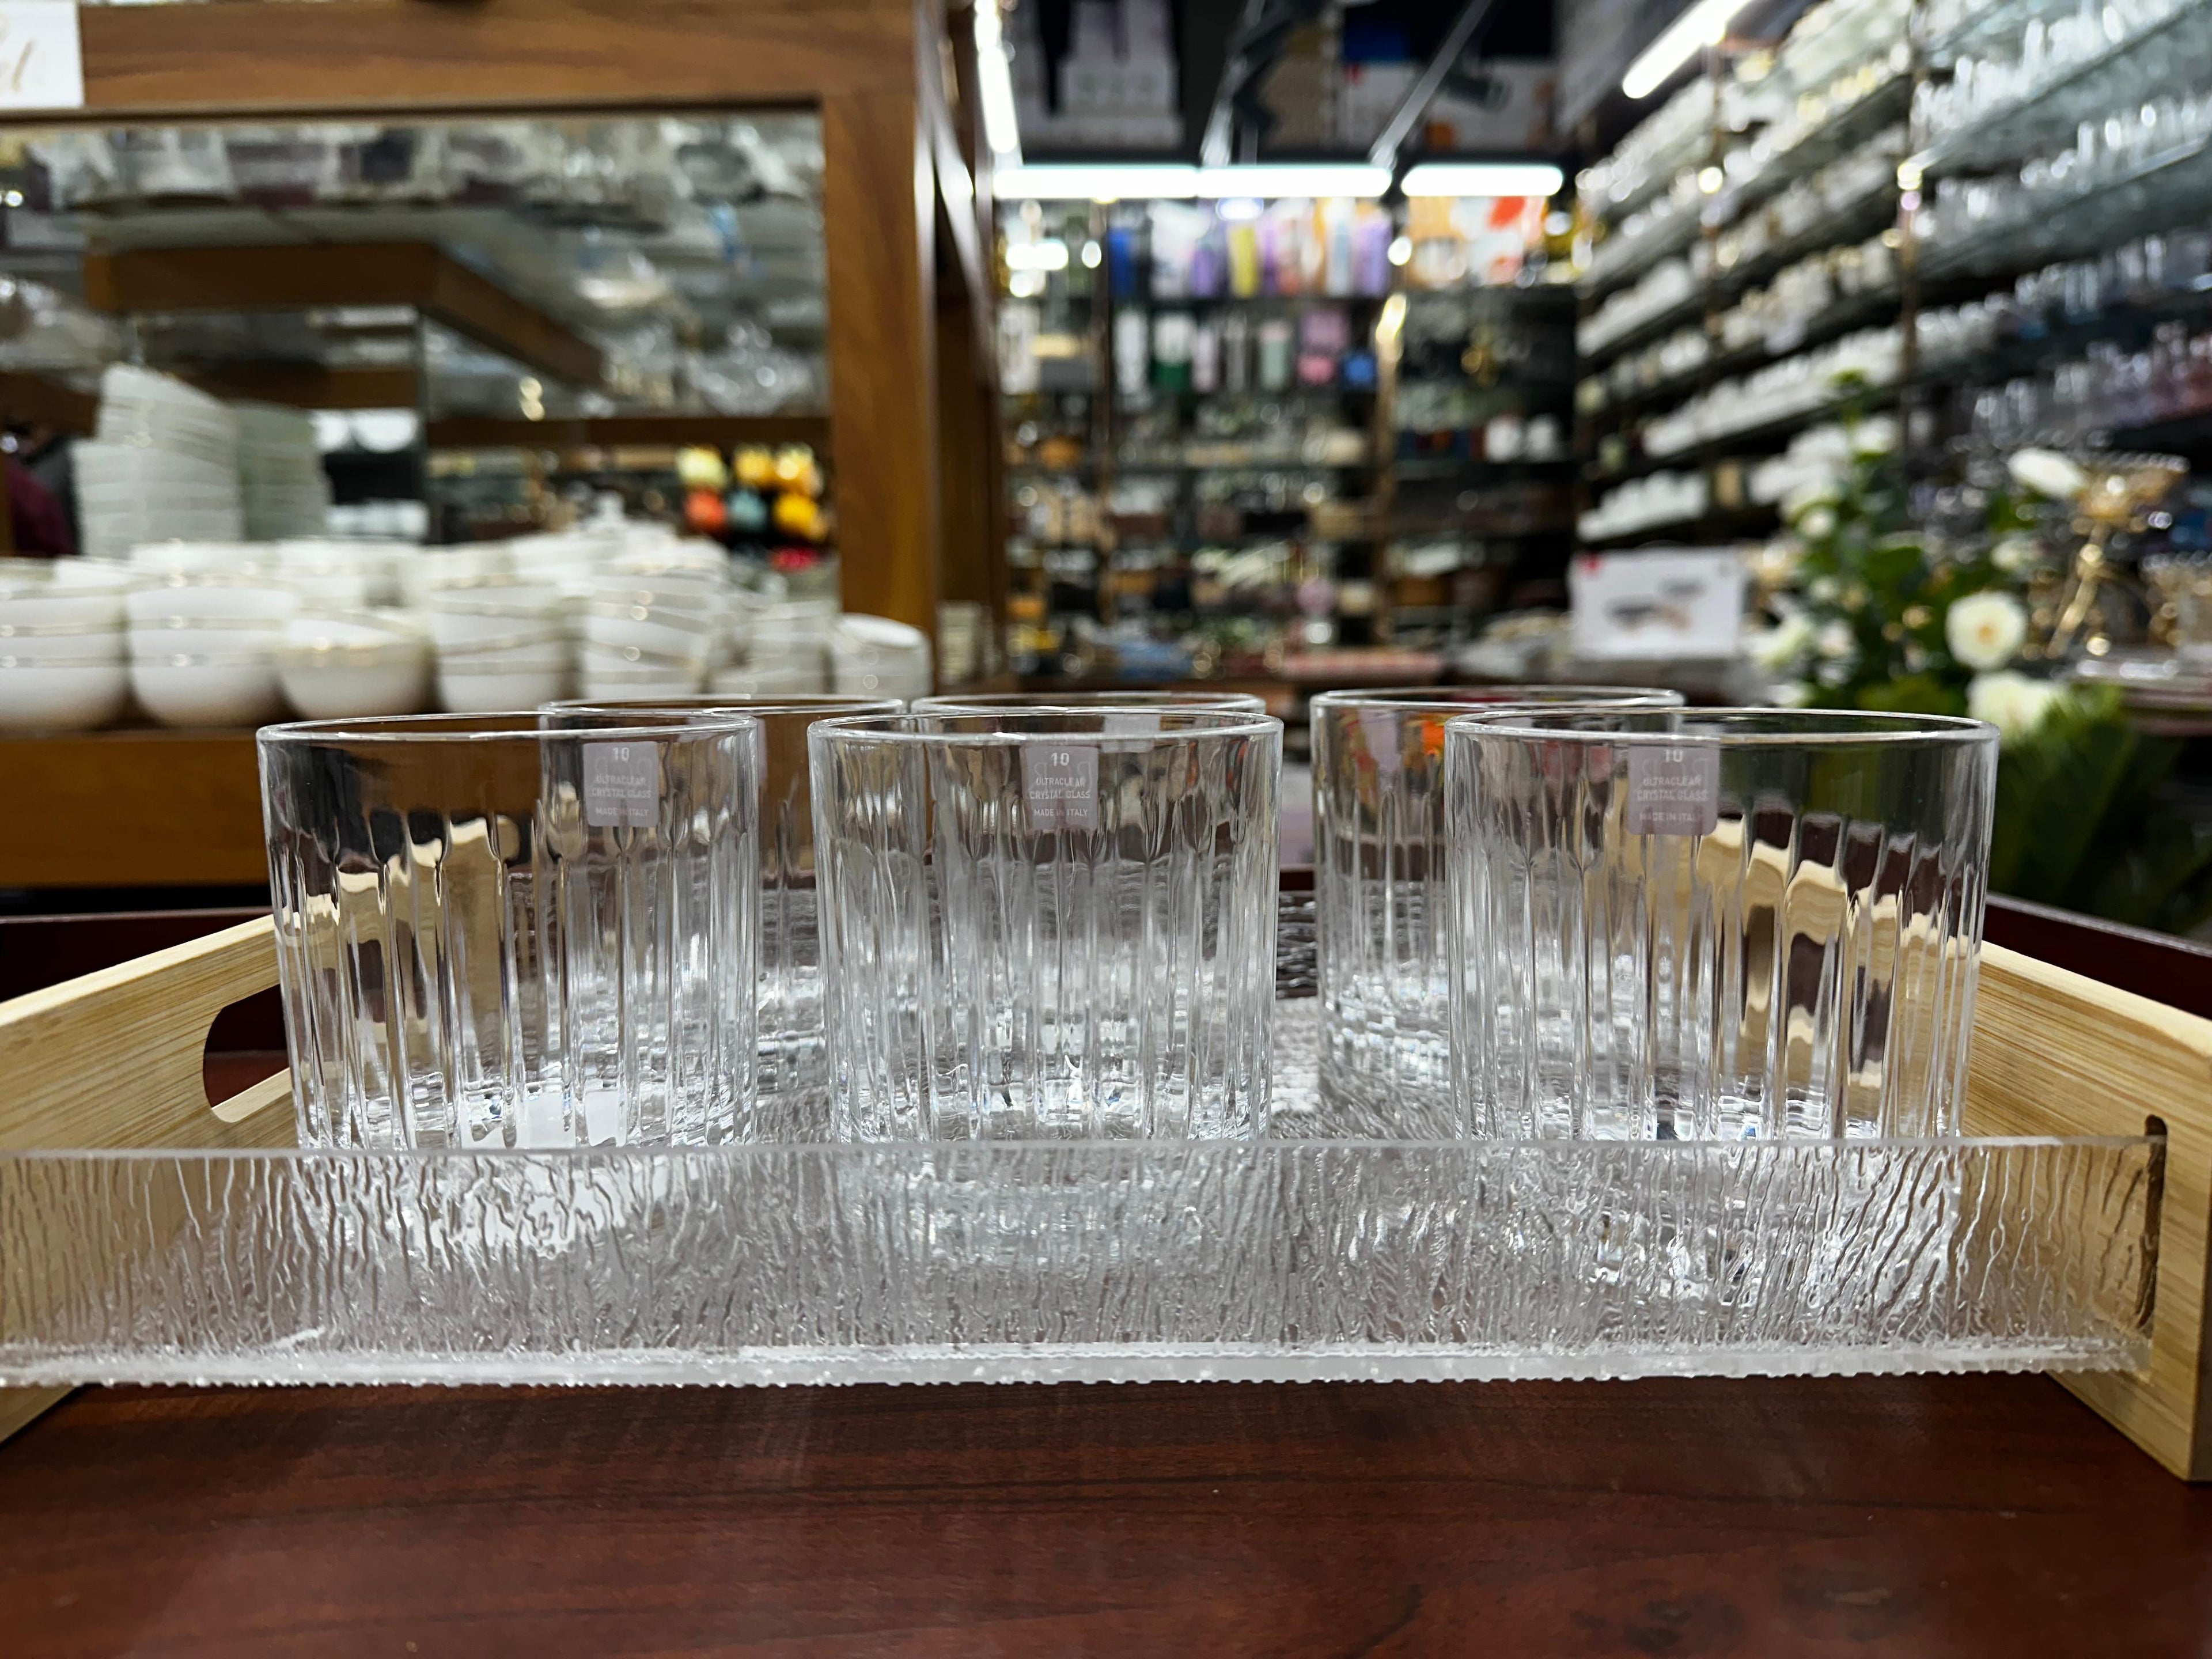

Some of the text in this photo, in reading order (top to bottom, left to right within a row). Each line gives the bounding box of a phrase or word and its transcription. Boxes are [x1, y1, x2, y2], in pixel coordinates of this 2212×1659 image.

[612, 747, 630, 763] 10
[1051, 752, 1070, 767] 10
[1663, 749, 1684, 763] 10
[1036, 777, 1086, 787] ULTRACLEAR
[1642, 776, 1702, 787] ULTRACLEAR
[1029, 790, 1090, 800] CRYSTAL GLASS
[1033, 808, 1054, 817] MADE
[1066, 808, 1088, 817] ITALY
